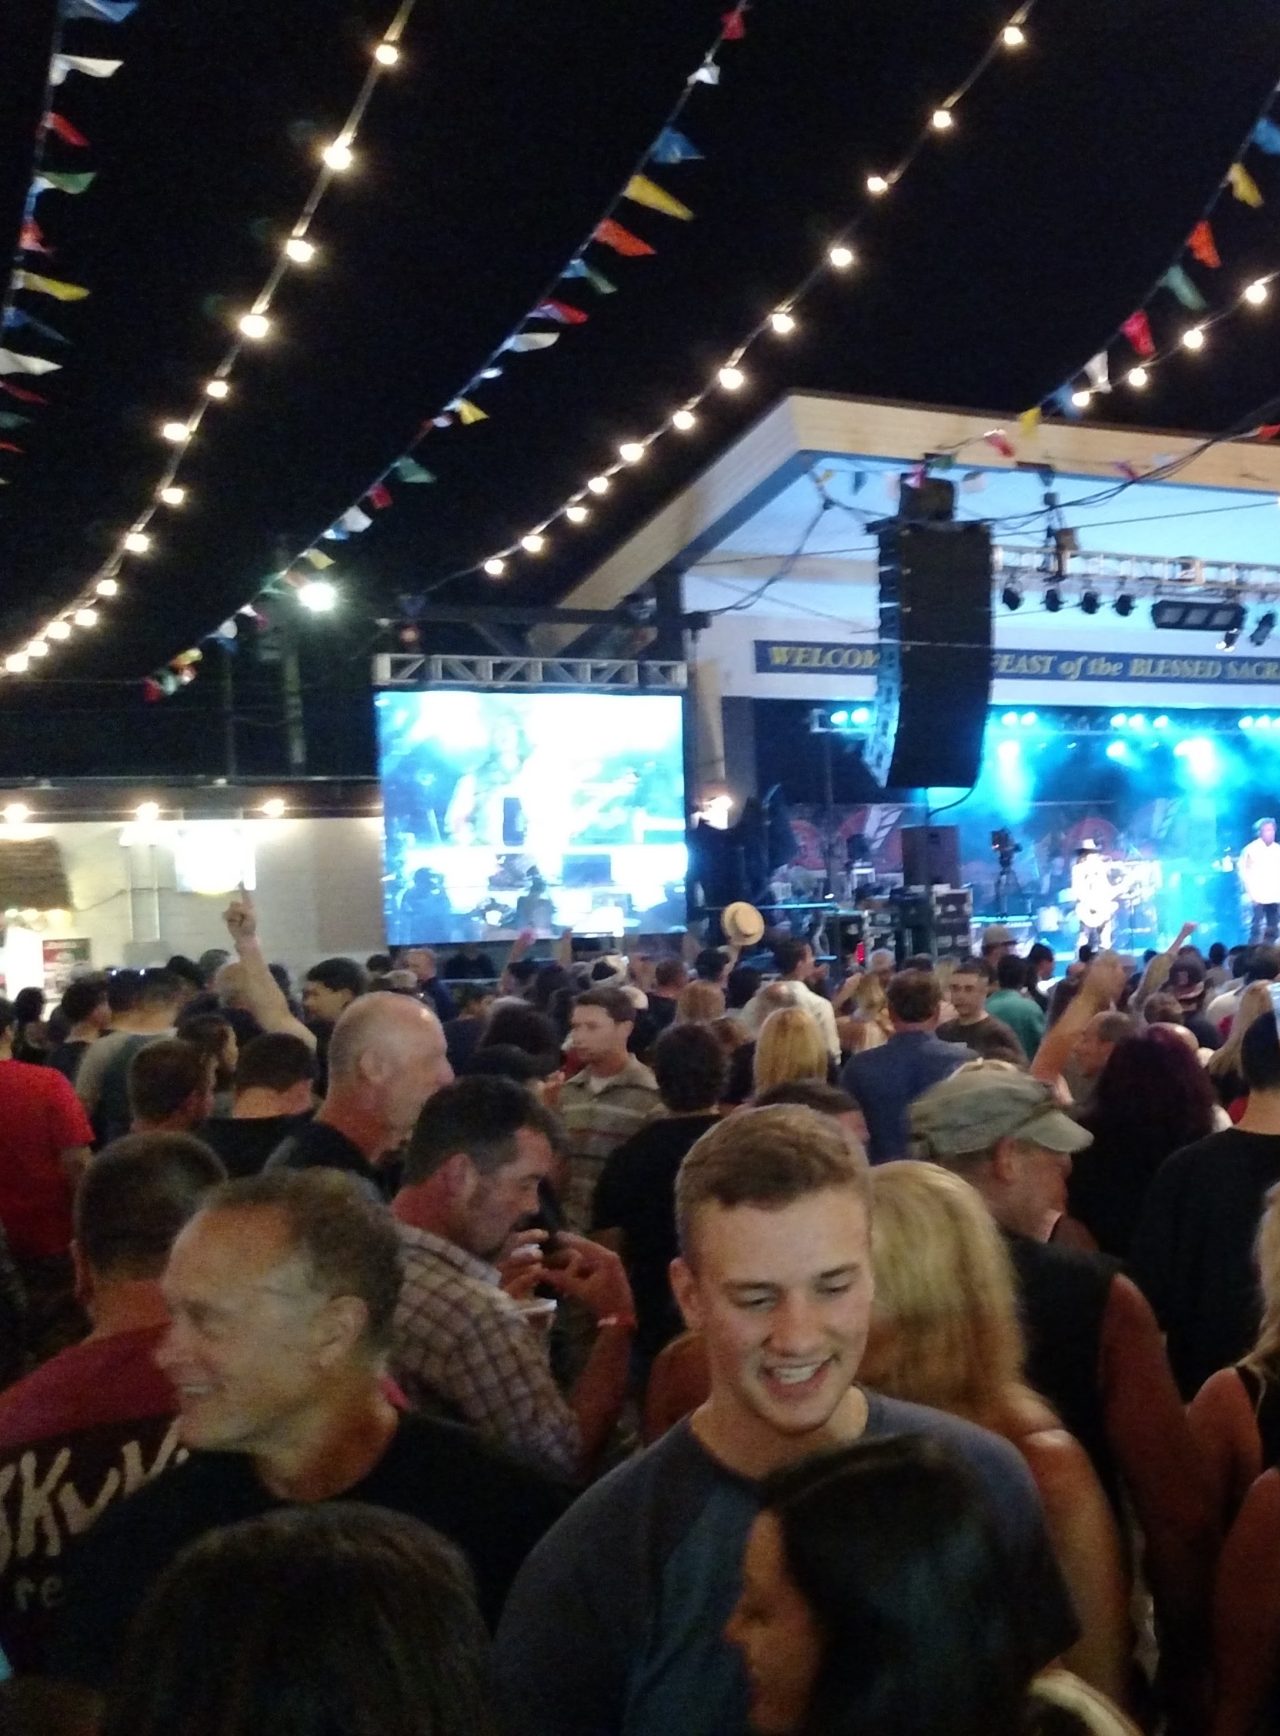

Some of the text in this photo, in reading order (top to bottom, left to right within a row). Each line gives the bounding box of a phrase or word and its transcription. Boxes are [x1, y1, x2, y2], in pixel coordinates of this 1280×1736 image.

[769, 646, 880, 669] WELCOM
[1058, 655, 1087, 680] of
[1087, 657, 1123, 676] the
[1129, 658, 1222, 678] BLESSED
